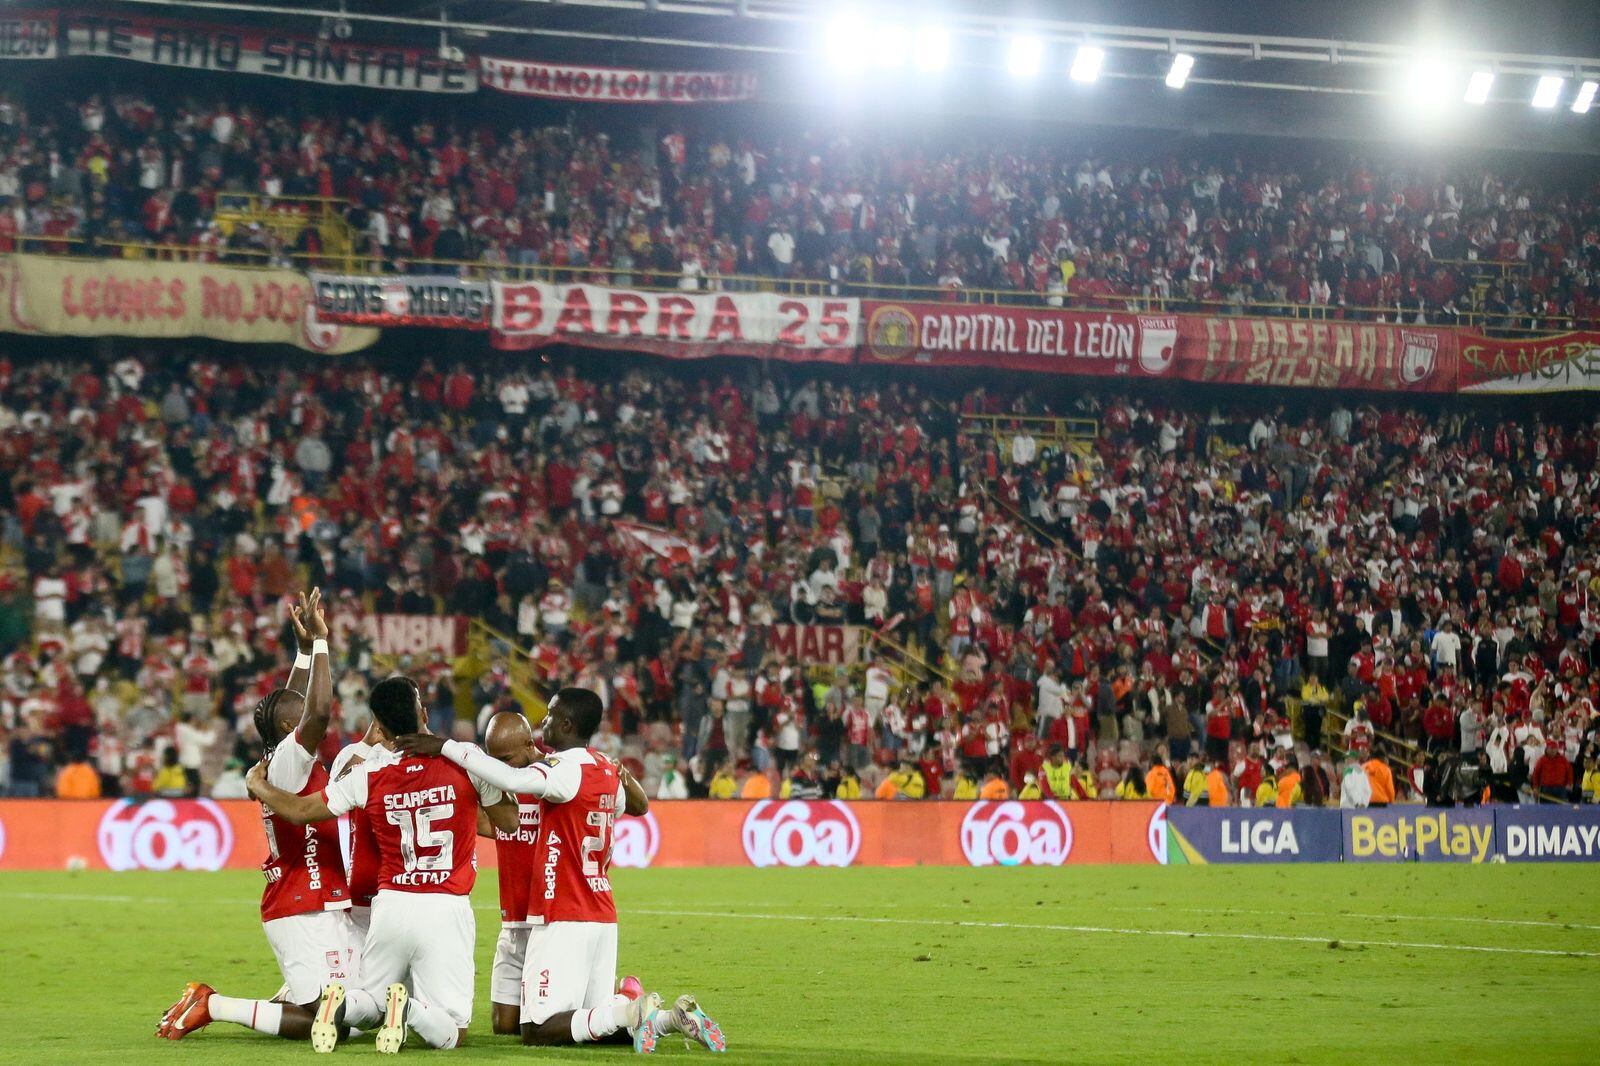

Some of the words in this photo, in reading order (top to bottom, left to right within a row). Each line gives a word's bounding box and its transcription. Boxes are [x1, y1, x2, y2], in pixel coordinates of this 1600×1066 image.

[153, 25, 241, 71] AMO
[62, 274, 187, 323] LEONES
[200, 275, 301, 325] ROJOS
[502, 285, 745, 341] BARRA
[777, 300, 850, 346] 25
[921, 313, 1021, 353] CAPITAL
[1026, 318, 1069, 356] DEL
[1074, 314, 1135, 359] LEÓN
[406, 764, 424, 774] FILA
[383, 785, 457, 811] SCARPETA
[385, 803, 454, 872] 15
[1221, 819, 1300, 855] LIGA
[1351, 812, 1493, 864] BetPlay
[1506, 824, 1600, 857] DIMAY
[304, 838, 321, 891] BetPlay
[544, 846, 561, 900] BetPlay
[538, 969, 550, 998] FILA
